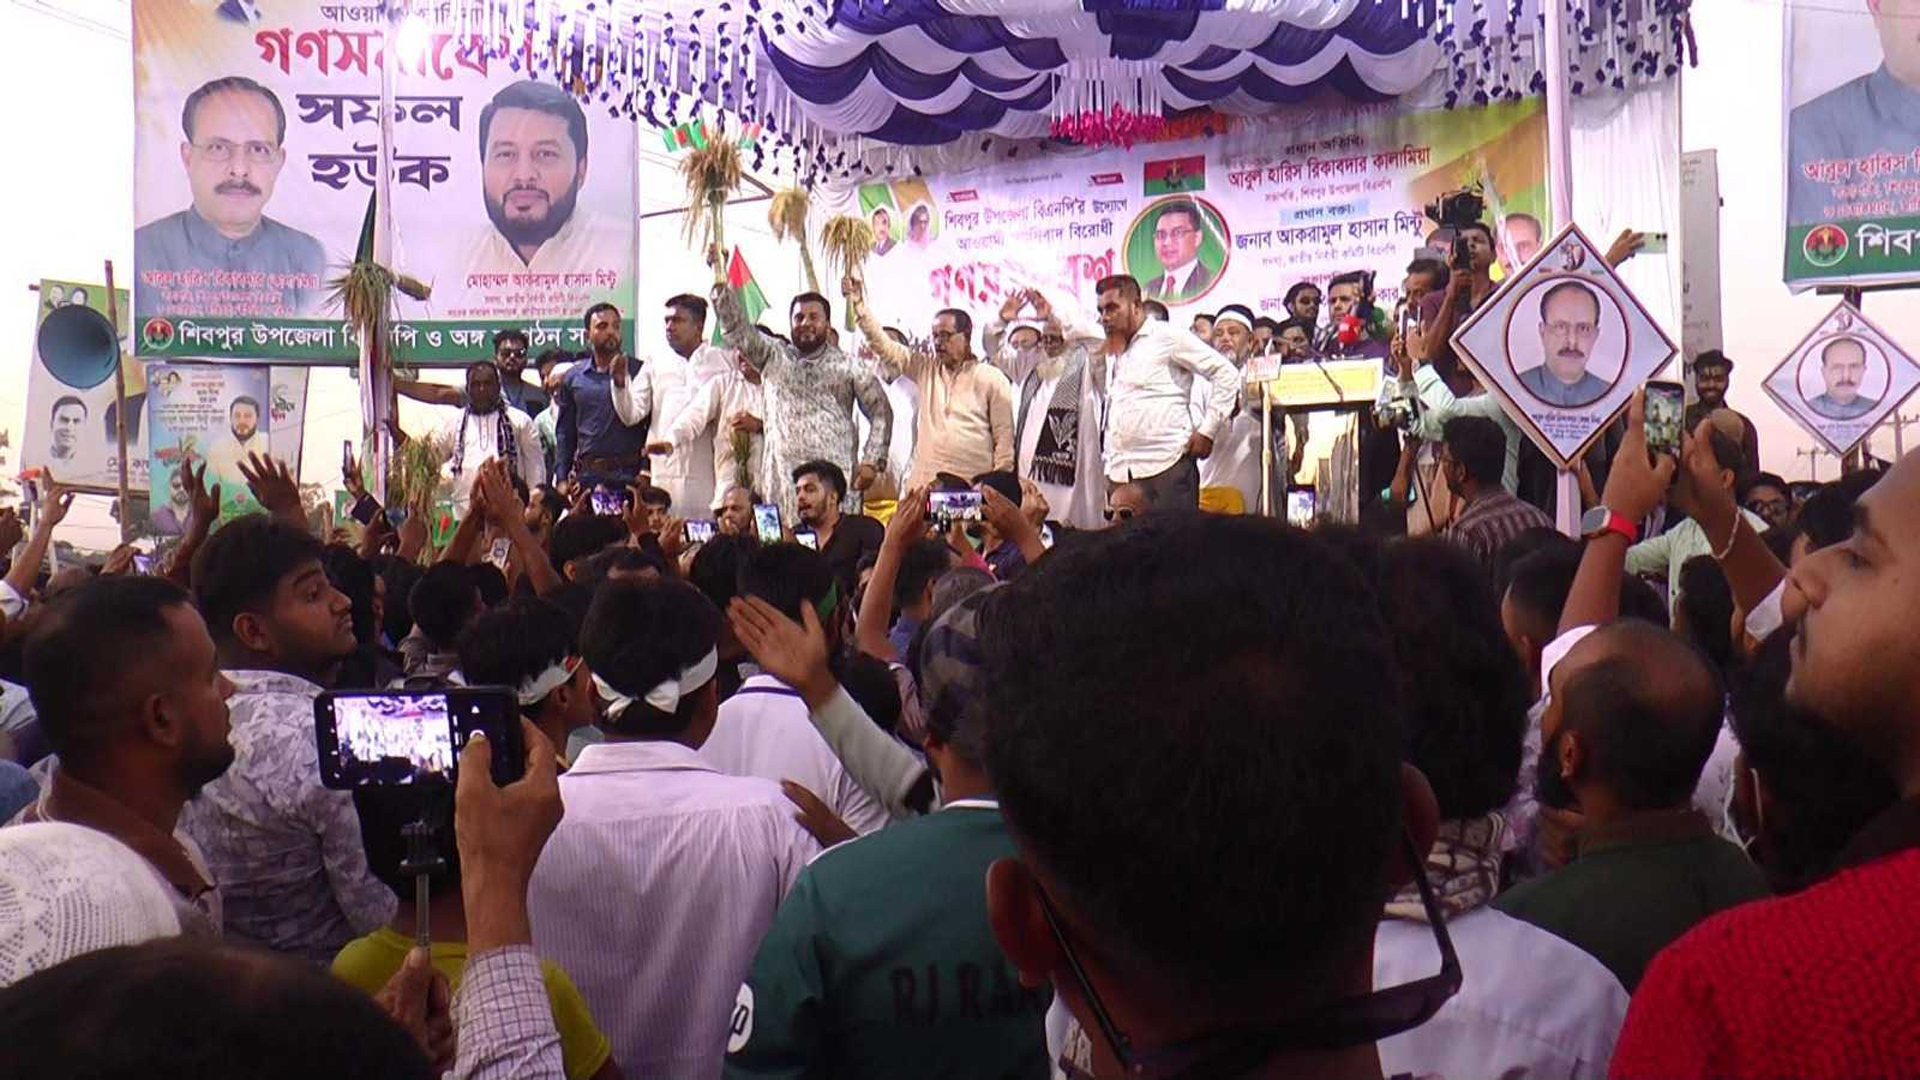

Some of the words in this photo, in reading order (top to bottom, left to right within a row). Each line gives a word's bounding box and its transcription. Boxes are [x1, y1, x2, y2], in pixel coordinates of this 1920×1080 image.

[1267, 160, 1302, 184] হারিস
[1069, 218, 1114, 240] বিরোধী
[1235, 231, 1272, 250] জনাব
[1347, 216, 1388, 237] হাসান
[1855, 223, 1920, 258] শিব
[178, 318, 244, 351] শিবপুর
[251, 320, 335, 348] উপজেলা
[425, 330, 443, 347] ও
